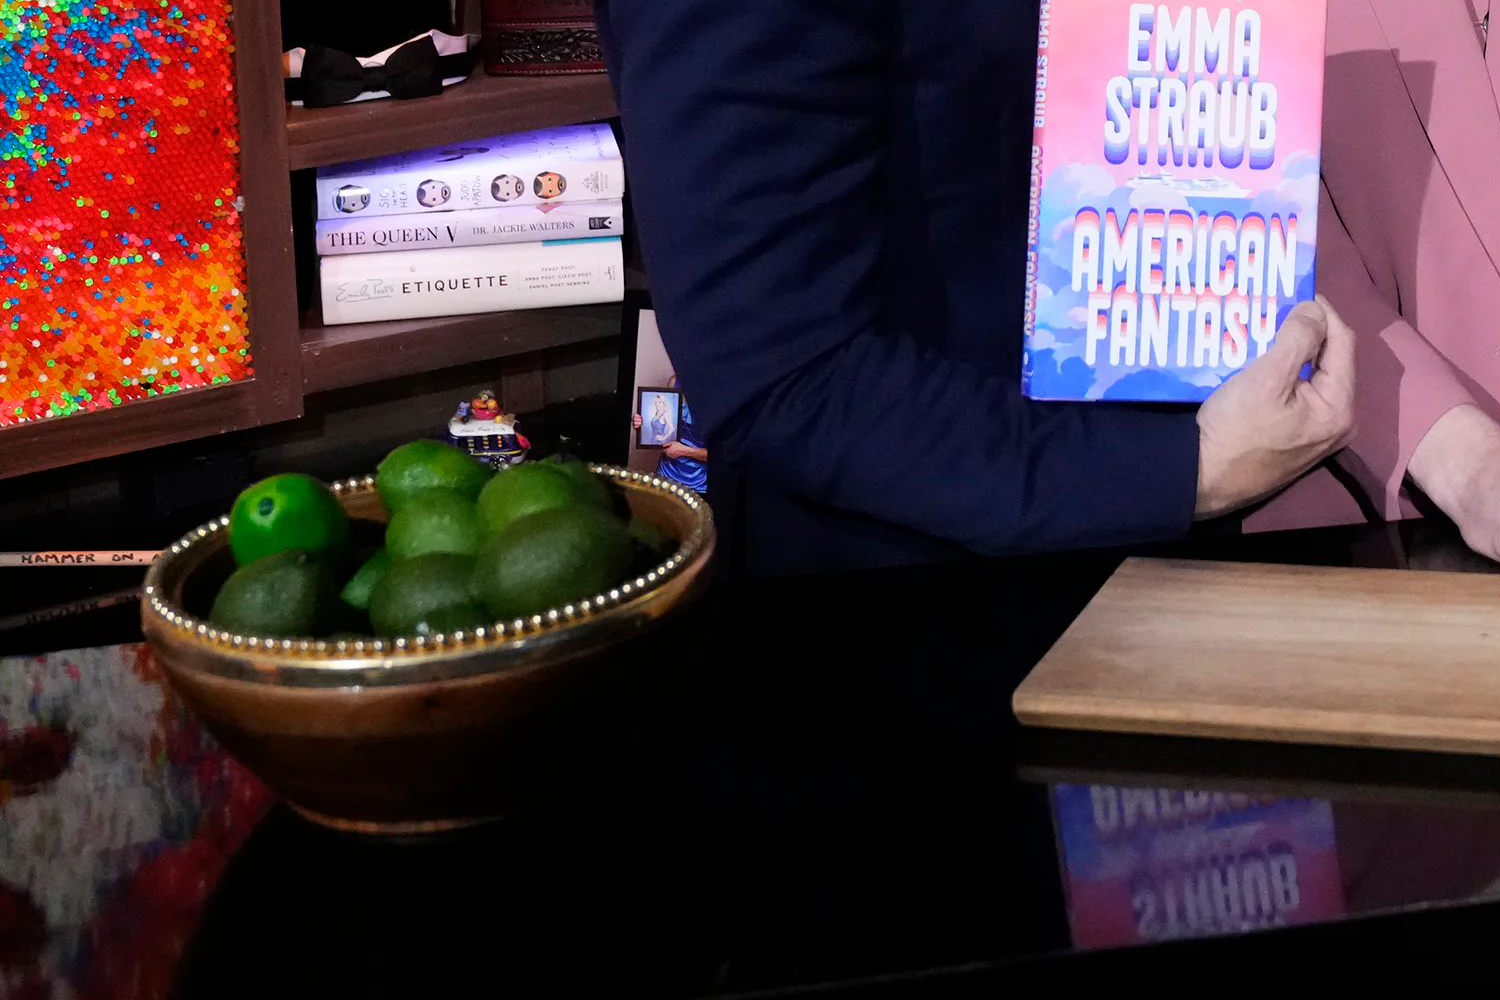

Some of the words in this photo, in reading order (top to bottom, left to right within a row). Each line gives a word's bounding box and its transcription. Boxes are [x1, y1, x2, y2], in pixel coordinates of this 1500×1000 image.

[1127, 3, 1262, 80] EMMA
[1034, 55, 1048, 127] STRAUB
[1104, 76, 1278, 163] STRAUB
[379, 186, 390, 208] SIC
[327, 231, 367, 247] THE
[372, 226, 438, 246] QUEEN
[445, 221, 458, 244] V
[472, 226, 489, 236] DR.
[491, 223, 527, 235] JACKIE
[528, 221, 575, 233] WALTERS
[1071, 208, 1298, 298] AMERICAN
[402, 275, 508, 294] ETIQUETTE
[1085, 286, 1278, 369] FANTASY
[22, 553, 95, 563] HAMMER
